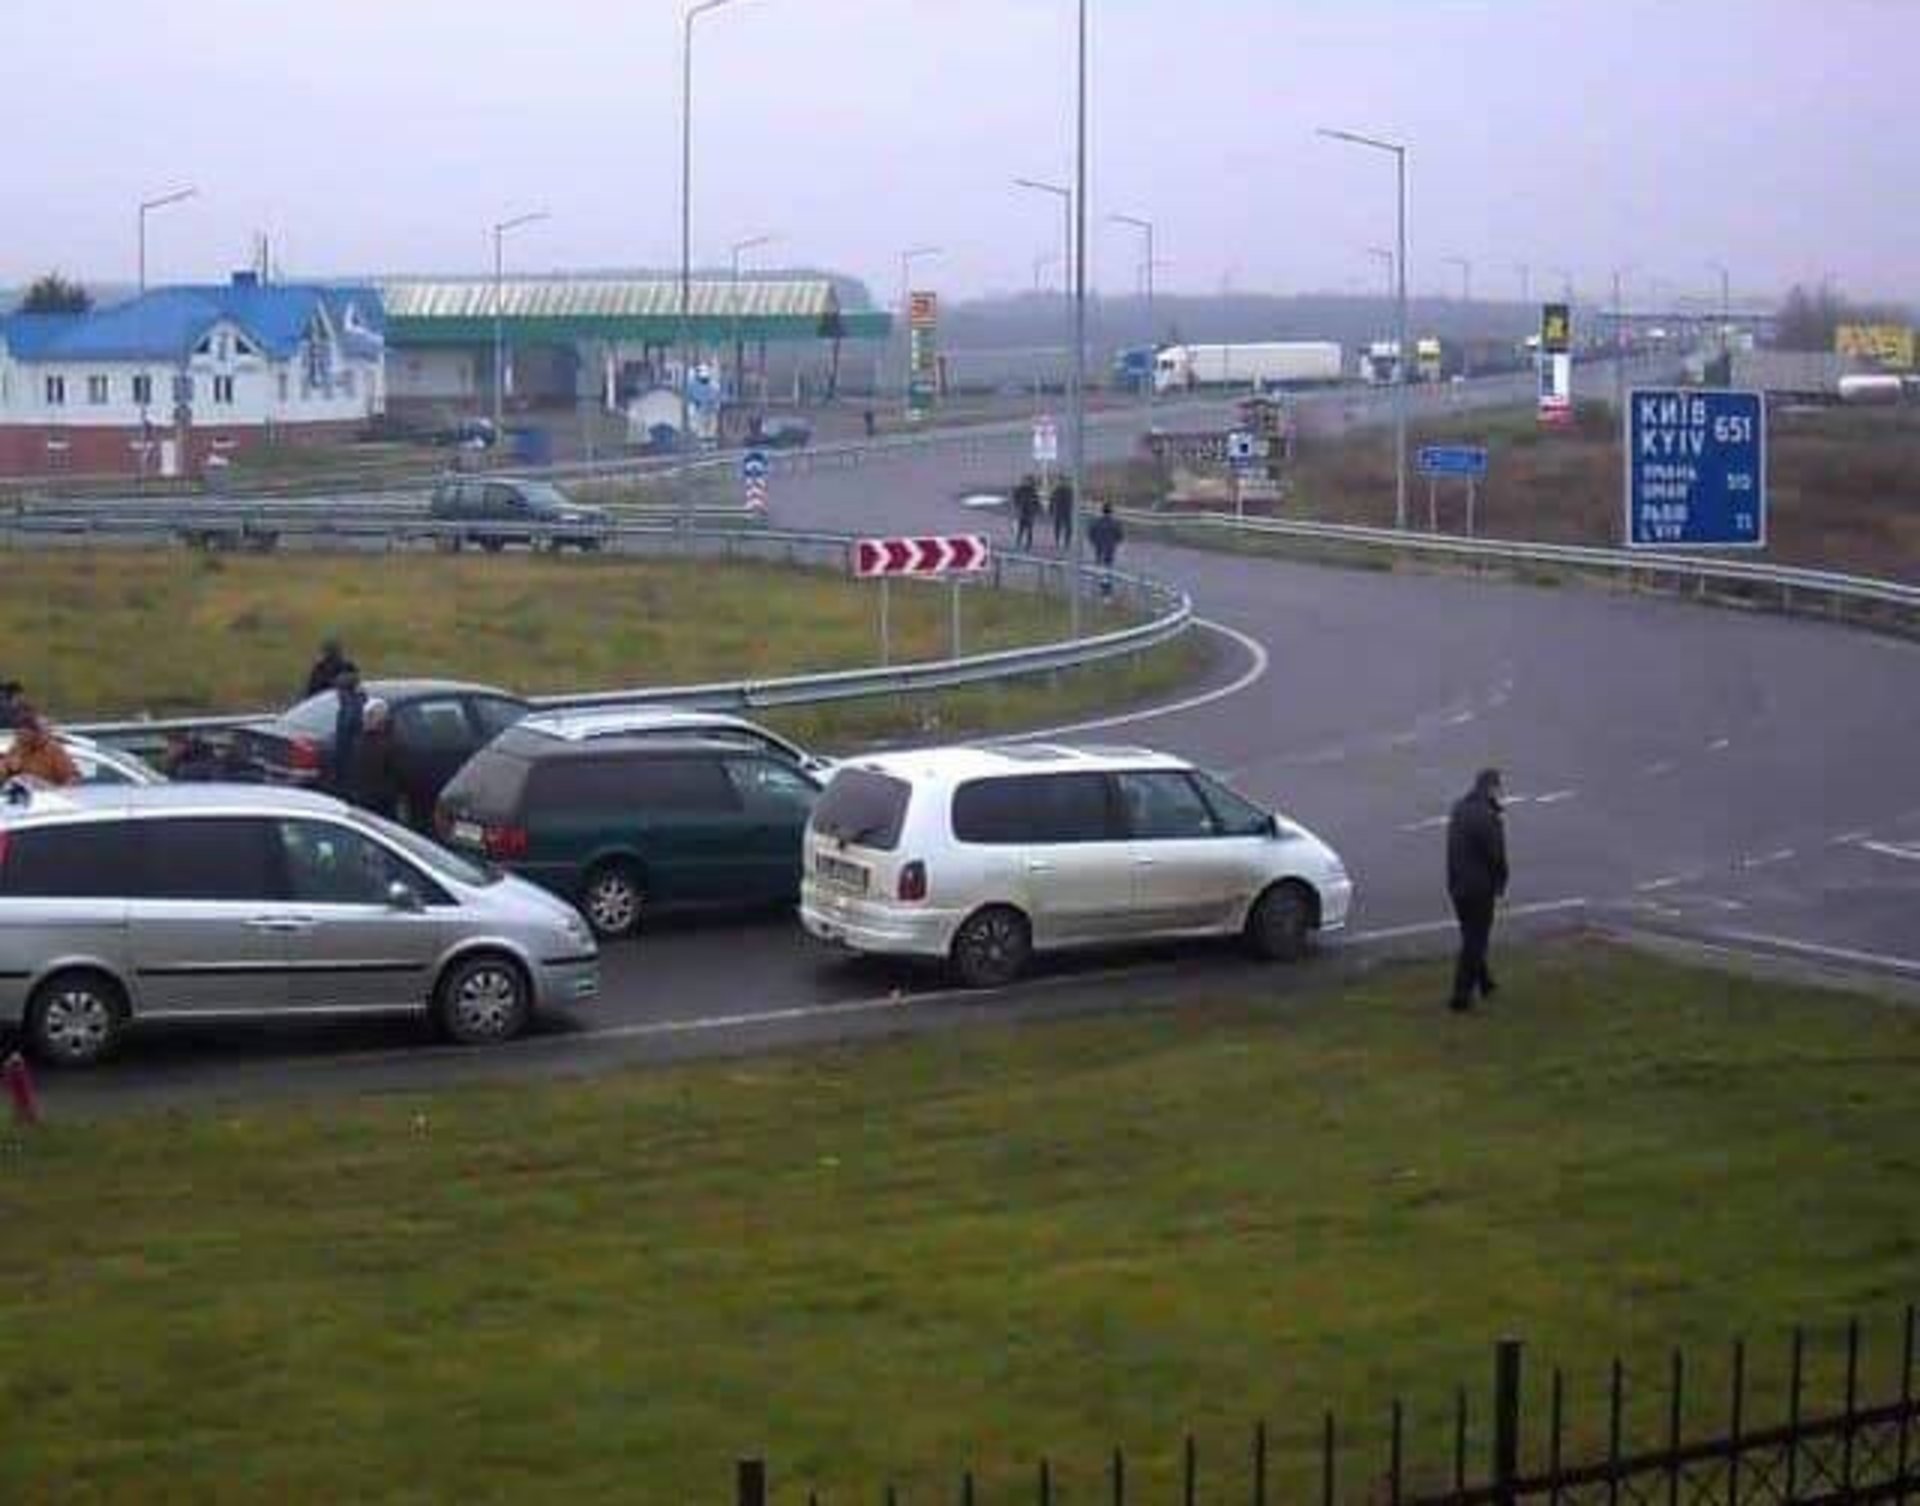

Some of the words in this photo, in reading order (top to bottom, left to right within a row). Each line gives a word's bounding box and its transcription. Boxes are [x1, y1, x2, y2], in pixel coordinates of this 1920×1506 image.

[1641, 394, 1705, 425] КИЇВ
[1642, 428, 1705, 456] KYIV
[1714, 415, 1752, 443] 651
